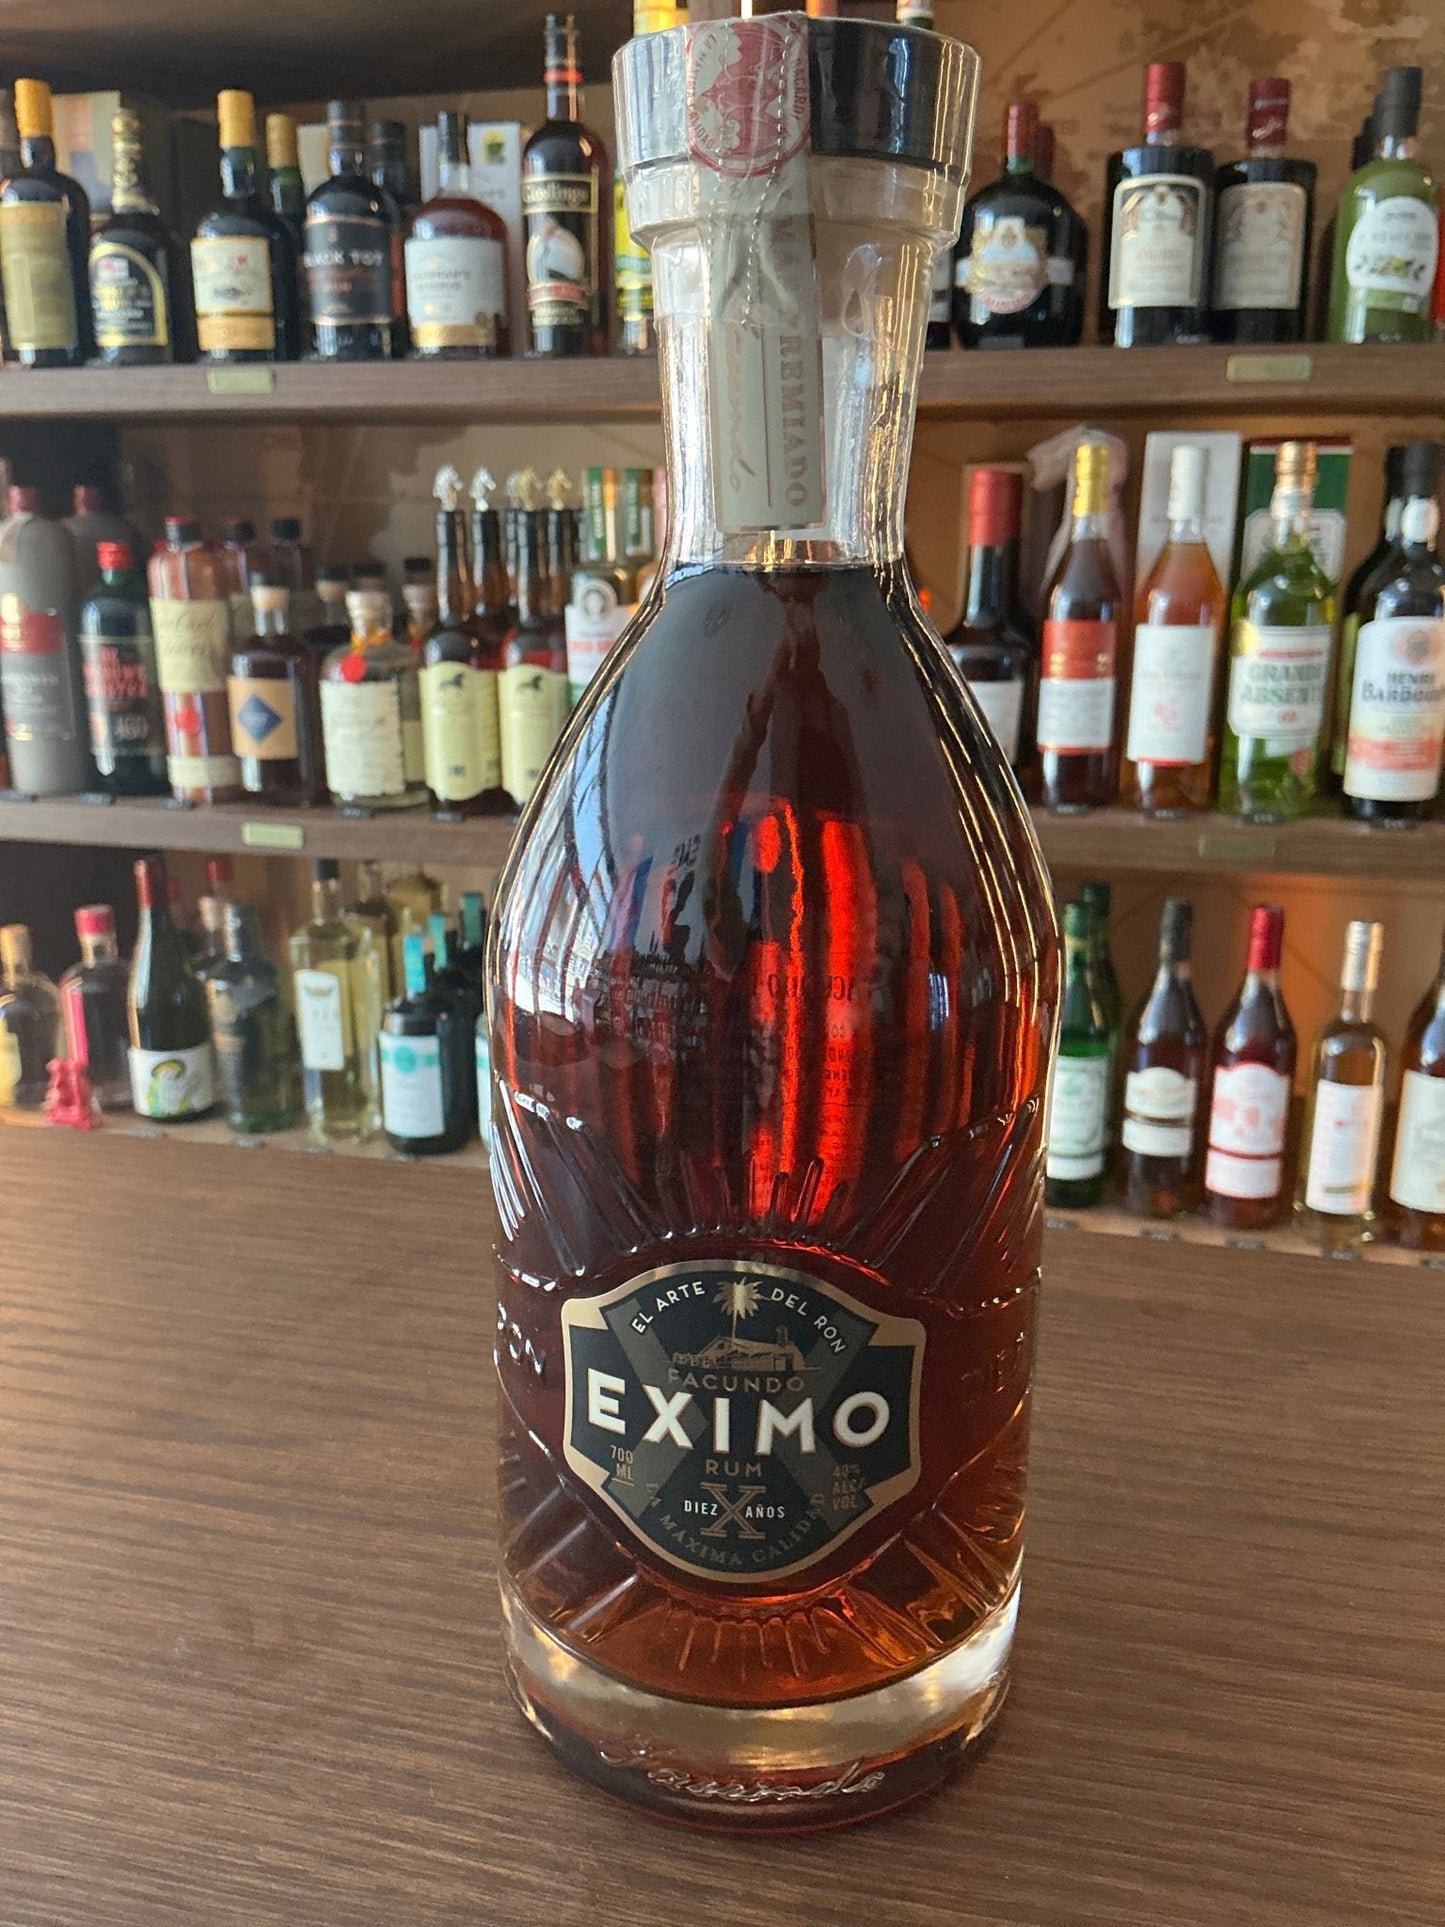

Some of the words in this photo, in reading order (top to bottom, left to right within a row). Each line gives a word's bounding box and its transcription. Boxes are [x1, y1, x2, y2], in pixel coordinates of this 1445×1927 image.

[631, 1310, 654, 1334] EL
[656, 1281, 706, 1312] ARTE
[770, 1287, 808, 1317] DEL
[813, 1315, 847, 1354] RON
[667, 1368, 806, 1394] FACUNDO
[587, 1367, 891, 1456] EXIMO
[610, 1445, 635, 1464] 700
[616, 1462, 635, 1481] ML
[705, 1458, 763, 1478] RUM
[684, 1500, 718, 1516] DIEZ
[745, 1503, 786, 1519] AÑOS
